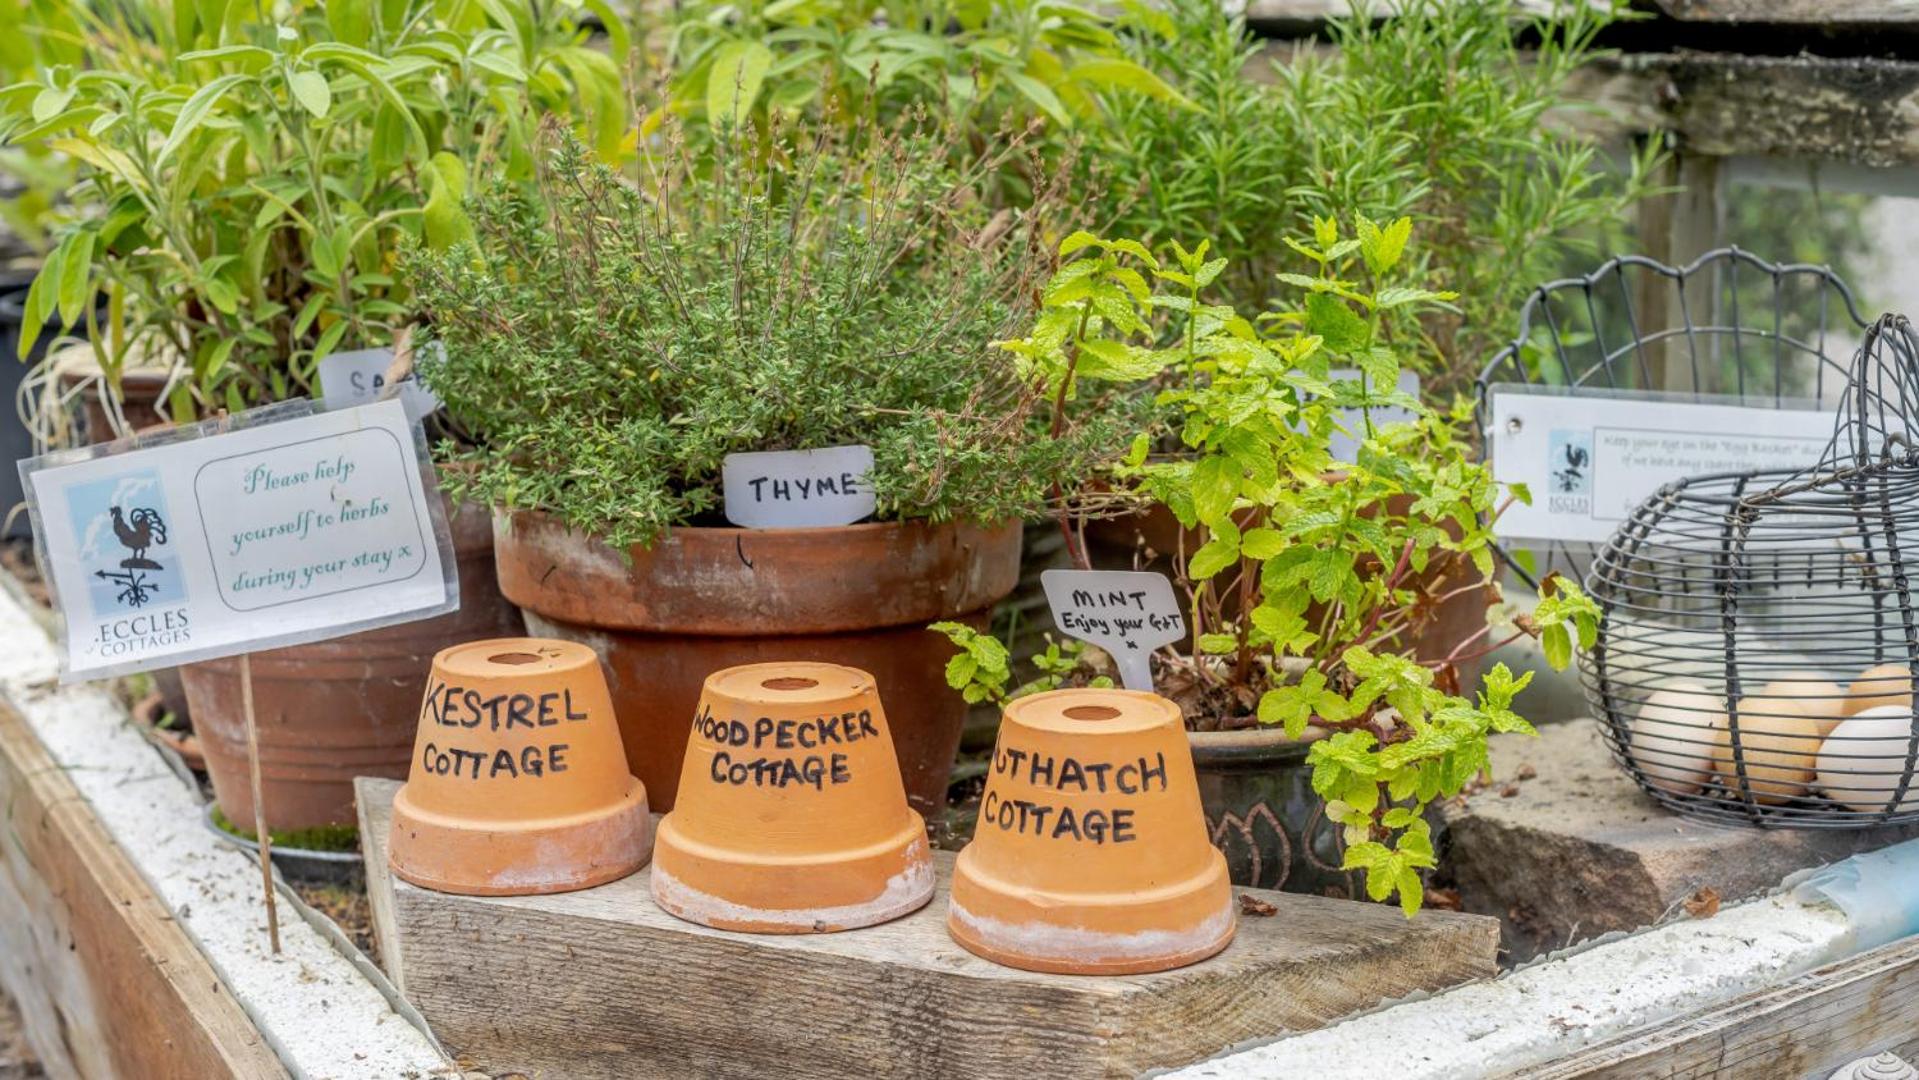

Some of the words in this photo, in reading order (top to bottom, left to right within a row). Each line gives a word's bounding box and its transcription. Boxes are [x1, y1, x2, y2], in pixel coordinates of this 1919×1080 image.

[244, 463, 309, 494] Please
[315, 455, 355, 483] help
[749, 473, 857, 502] THYME
[230, 509, 315, 556] yourself
[317, 514, 335, 528] to
[340, 498, 389, 523] herbs
[232, 568, 297, 592] during
[300, 560, 347, 589] your
[352, 549, 393, 573] stay
[1072, 590, 1146, 610] MINT
[100, 608, 188, 642] ECCLES
[100, 628, 191, 657] COTTAGES
[1062, 612, 1110, 635] Enjoy
[1114, 618, 1143, 637] your
[423, 679, 587, 731] KESTREL
[994, 733, 1168, 795] UTHATCH
[985, 790, 1136, 844] COTTAGE
